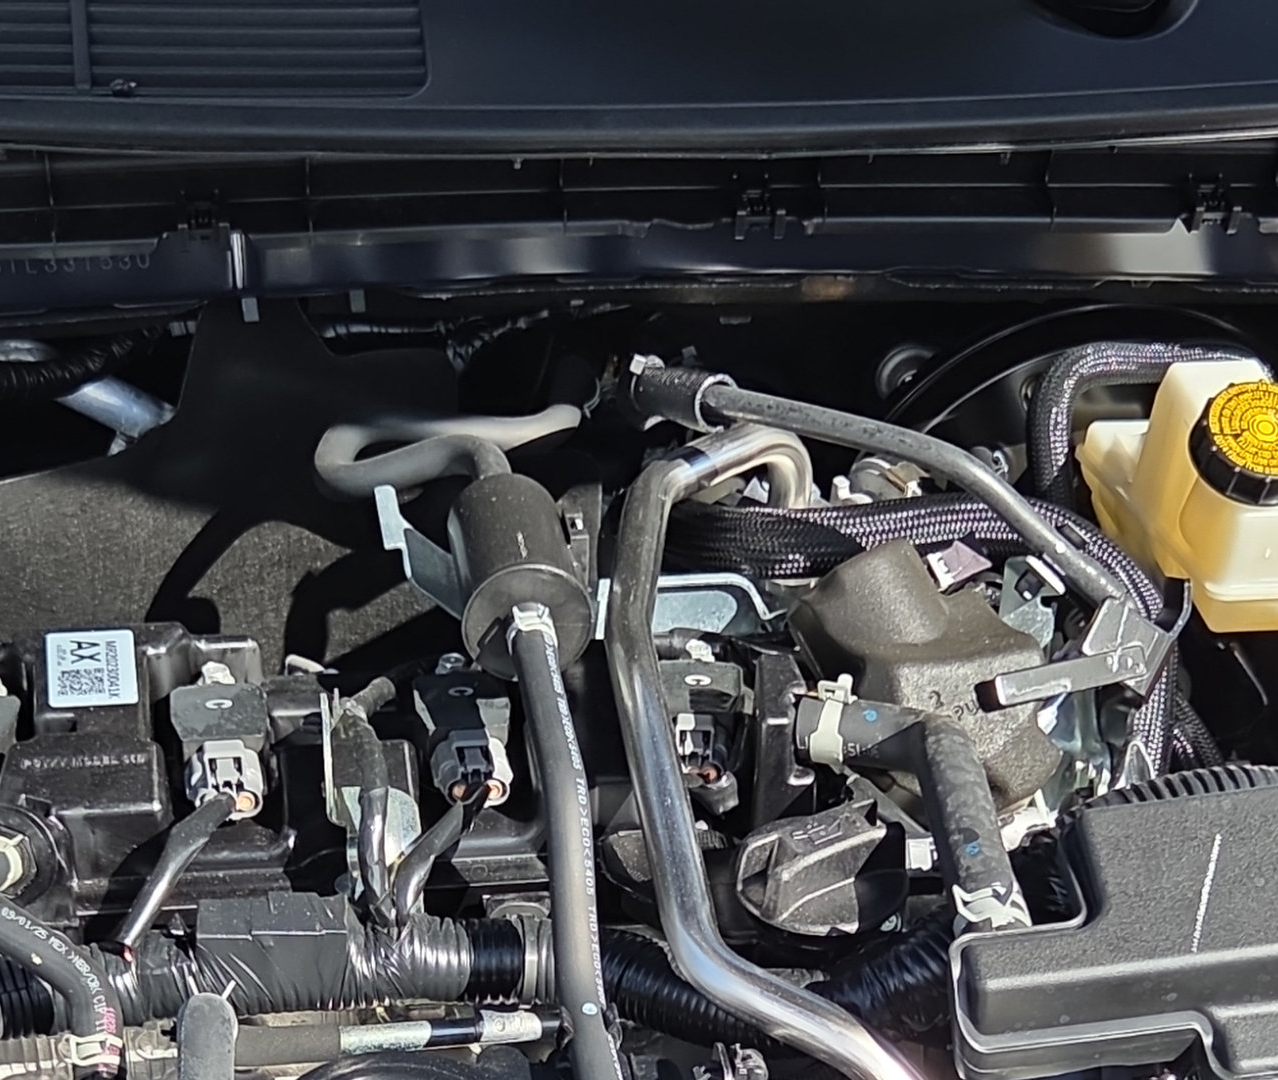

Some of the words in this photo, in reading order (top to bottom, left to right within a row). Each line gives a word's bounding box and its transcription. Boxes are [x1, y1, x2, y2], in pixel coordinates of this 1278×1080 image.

[69, 640, 102, 664] AX
[1, 907, 49, 941] 09/01/25
[49, 933, 70, 956] MEX
